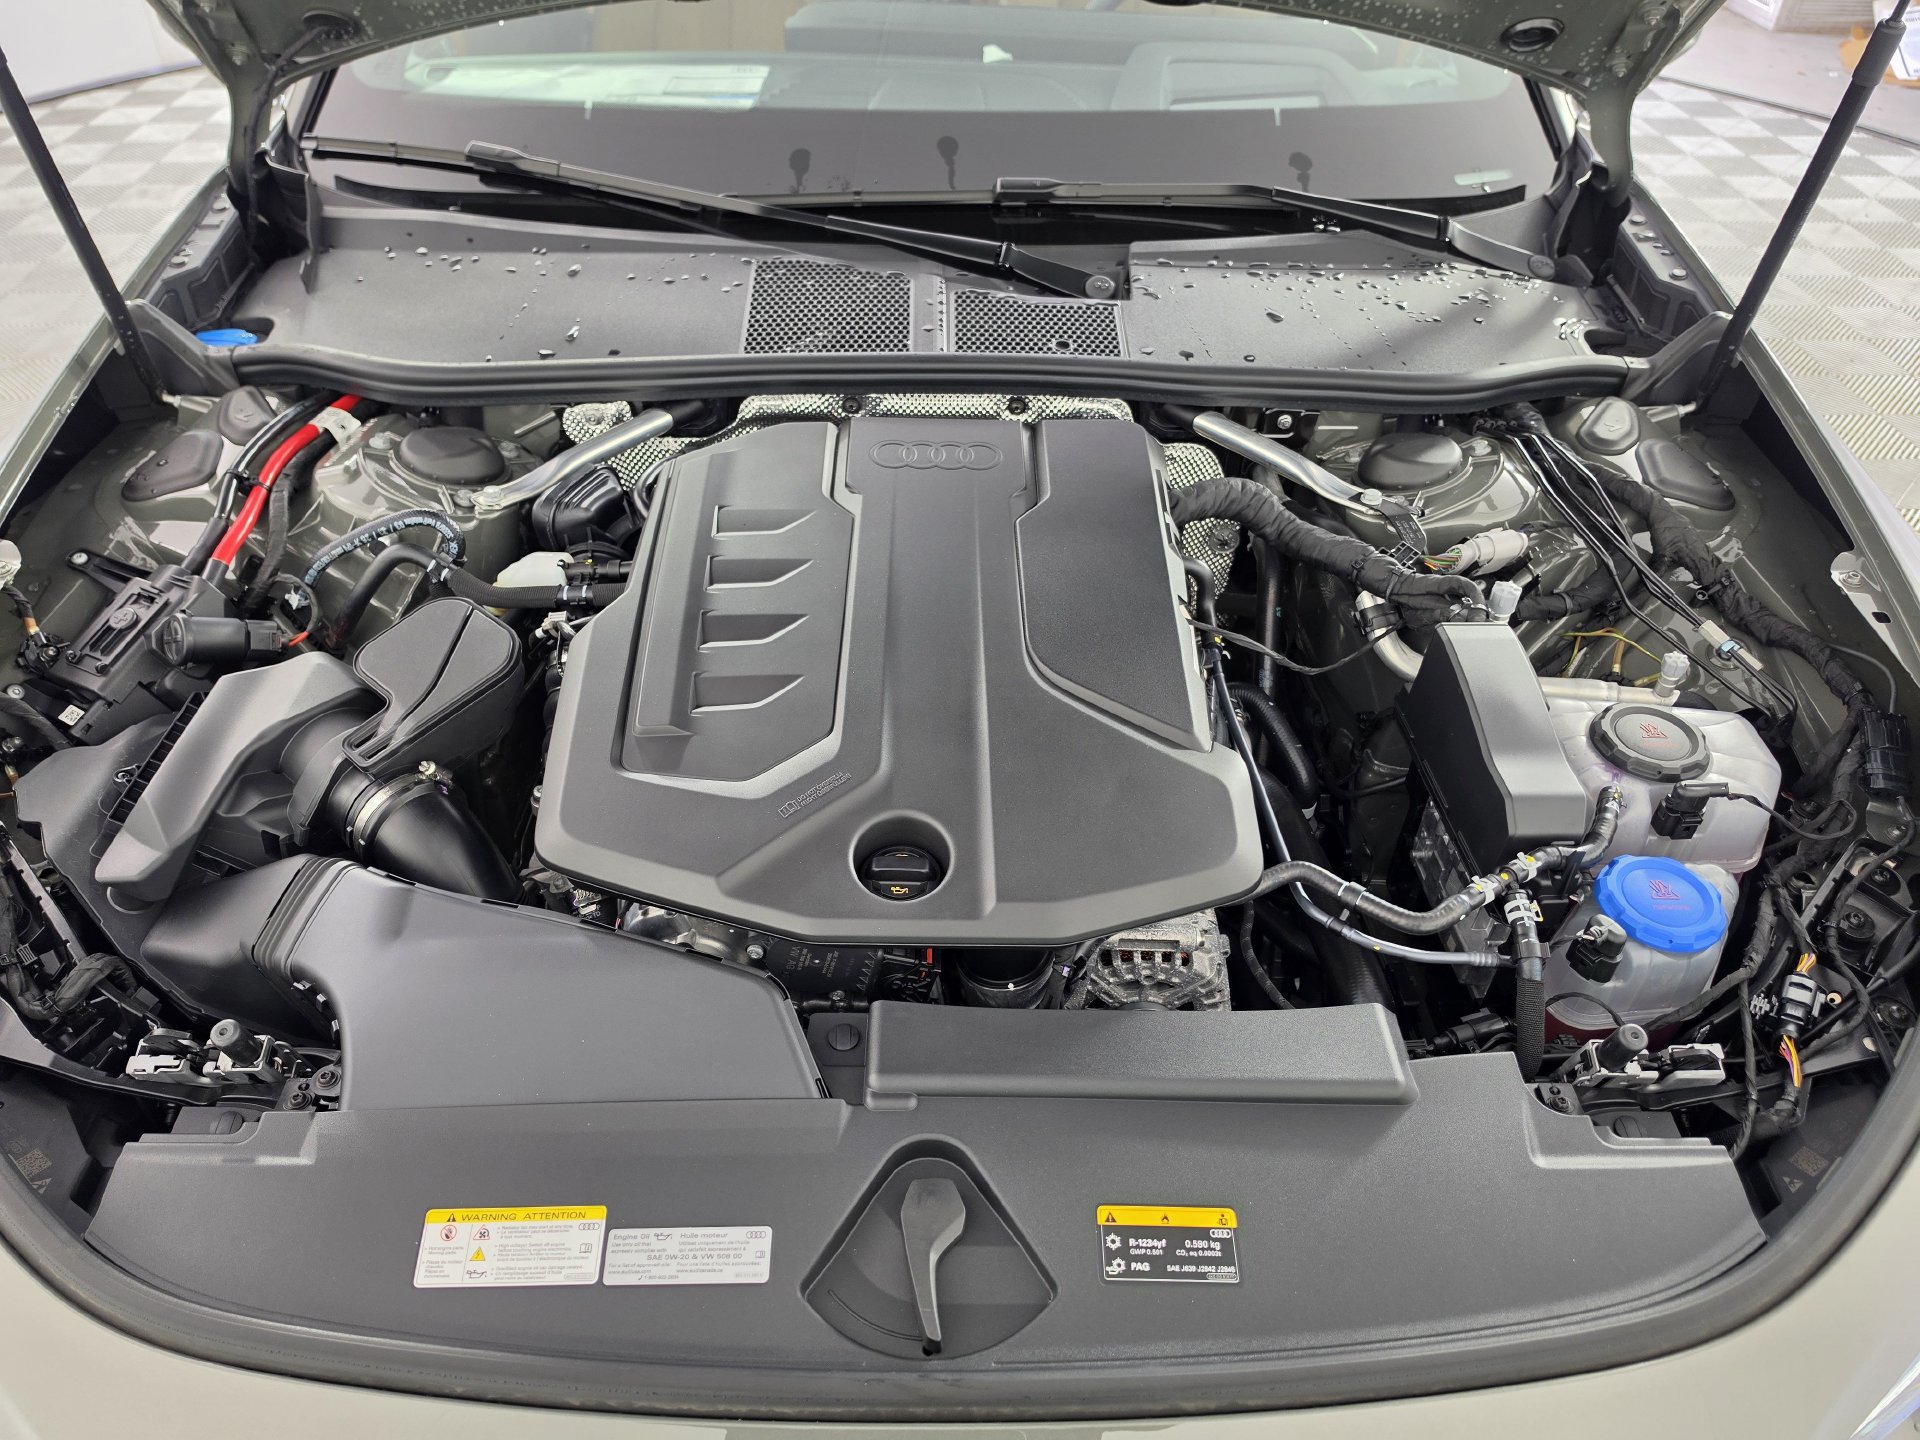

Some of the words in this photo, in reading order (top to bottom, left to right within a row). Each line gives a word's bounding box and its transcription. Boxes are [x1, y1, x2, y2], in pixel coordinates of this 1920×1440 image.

[461, 1213, 517, 1221] WARNING
[523, 1211, 587, 1220] ATTENTION
[614, 1233, 638, 1241] Engine
[1129, 1238, 1167, 1249] R-1234yf
[1210, 1240, 1221, 1251] kg
[1131, 1262, 1150, 1271] PAG
[1167, 1264, 1180, 1272] SAE
